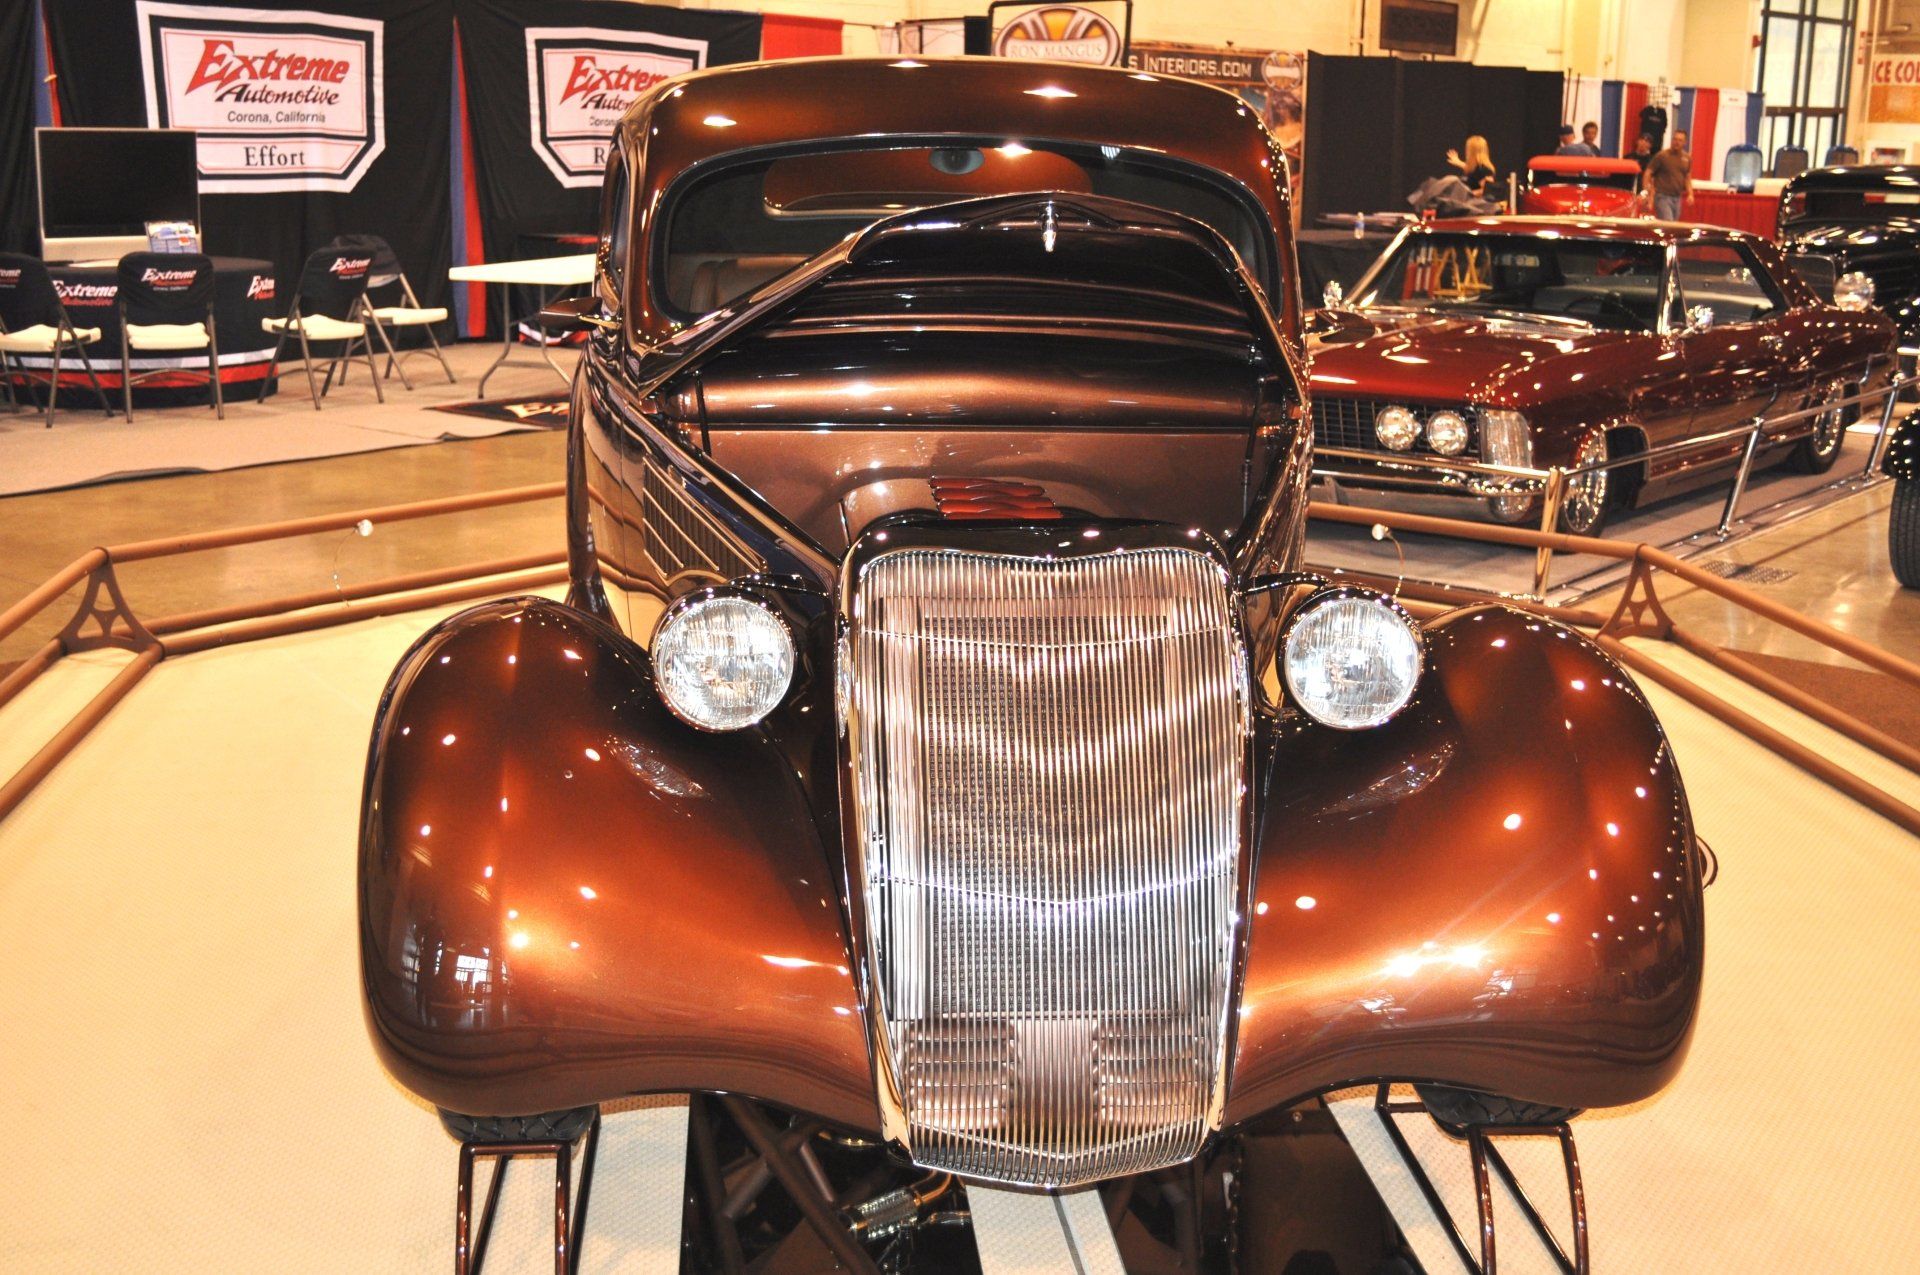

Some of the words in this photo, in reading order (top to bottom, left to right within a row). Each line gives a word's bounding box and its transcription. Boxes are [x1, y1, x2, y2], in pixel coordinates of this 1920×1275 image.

[185, 39, 350, 96] Extreme
[215, 83, 340, 105] Automotive
[227, 110, 272, 124] Corona,
[275, 110, 326, 123] California
[244, 146, 305, 166] Effort
